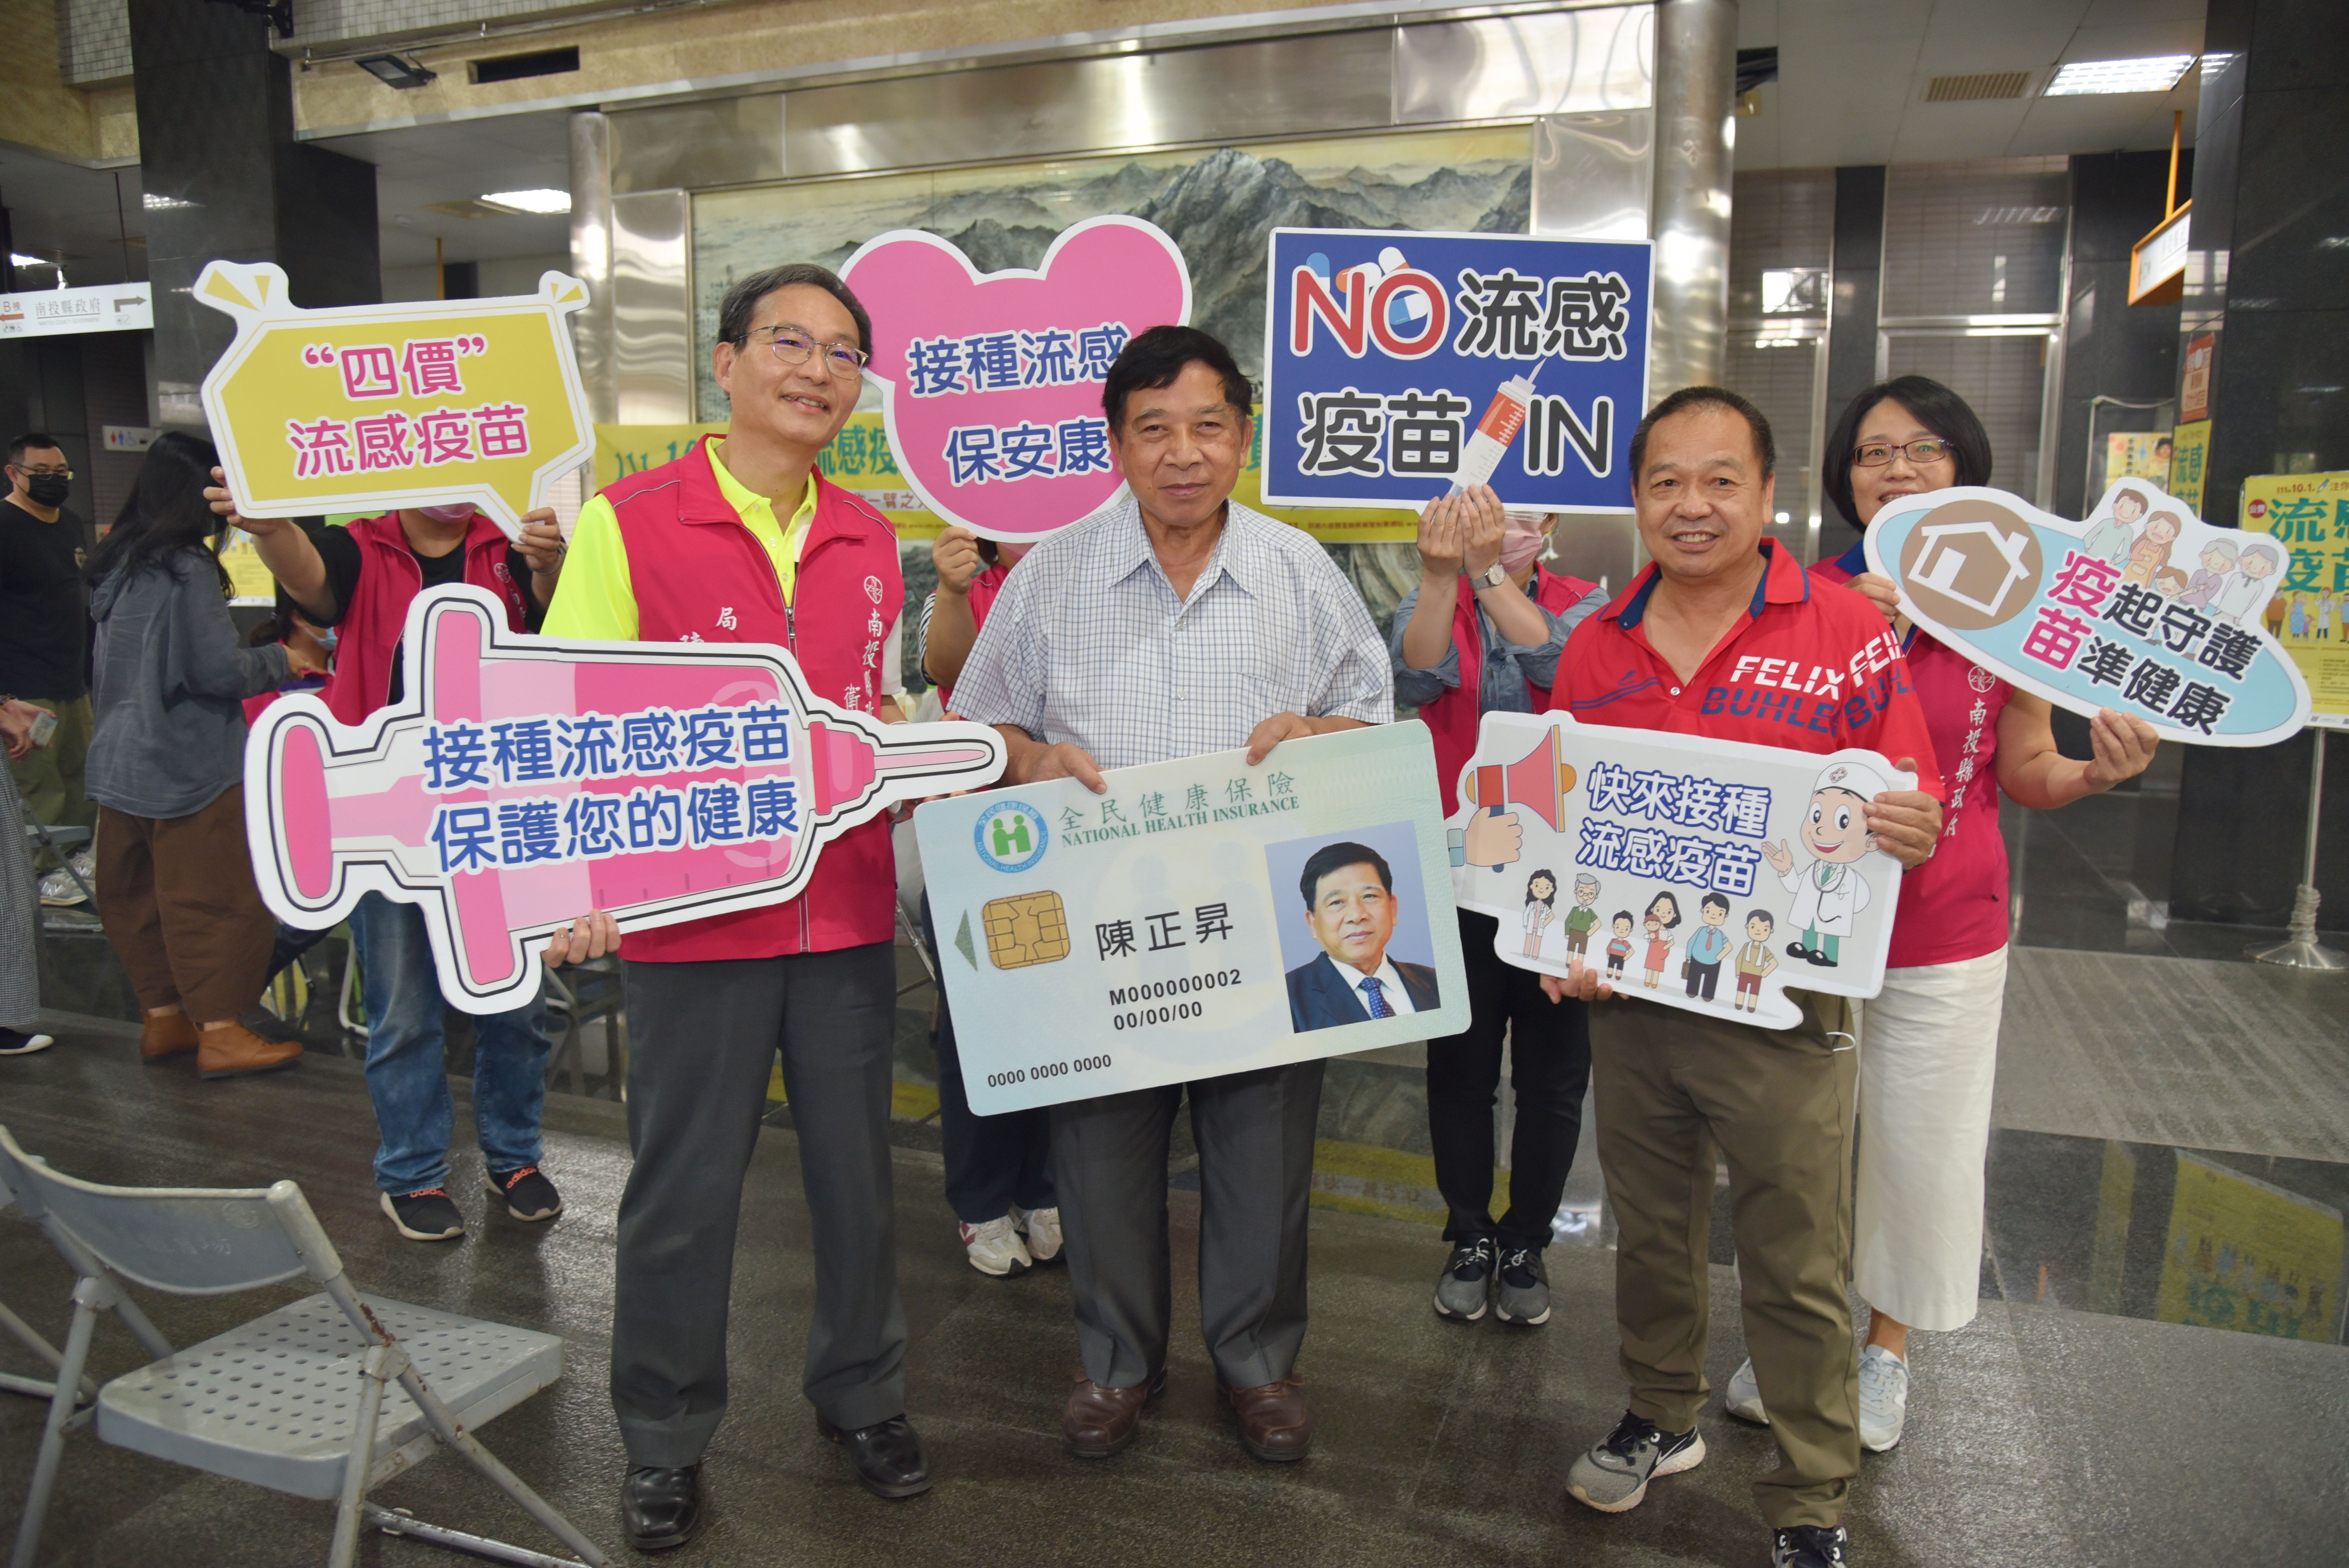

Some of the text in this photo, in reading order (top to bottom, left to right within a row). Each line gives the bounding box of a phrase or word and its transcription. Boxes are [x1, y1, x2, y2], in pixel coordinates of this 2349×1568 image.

[35, 297, 101, 317] 南投縣政府
[1294, 269, 1626, 356] NO 流感
[909, 325, 1128, 394] 接種流感
[290, 404, 528, 476] 流感疫苗
[946, 419, 1109, 483] 保安康
[1301, 391, 1468, 474] 疫苗
[1528, 399, 1609, 474] IN
[2268, 497, 2349, 543] 流
[715, 607, 737, 631] 局
[2048, 550, 2263, 680] 疫起守護
[1730, 655, 1845, 700] FELIX
[2023, 607, 2230, 736] 苗準健康
[421, 705, 791, 789] 接種流感疫苗
[1944, 697, 1987, 837] 南投縣政府
[430, 779, 800, 873] 保護您的健康
[1059, 771, 1295, 831] 全民健康保險
[1061, 795, 1300, 847] NATIONAL HEALTH INSURANCE
[1588, 762, 1771, 839] 快來接種
[976, 841, 999, 869] NATIONAL
[1576, 819, 1762, 896] 流感疫苗
[1095, 902, 1233, 961] 陳正昇
[1109, 969, 1242, 1006] M000000002
[1114, 1001, 1202, 1030] 00/00/00
[987, 1054, 1111, 1087] 0000 0000 0000
